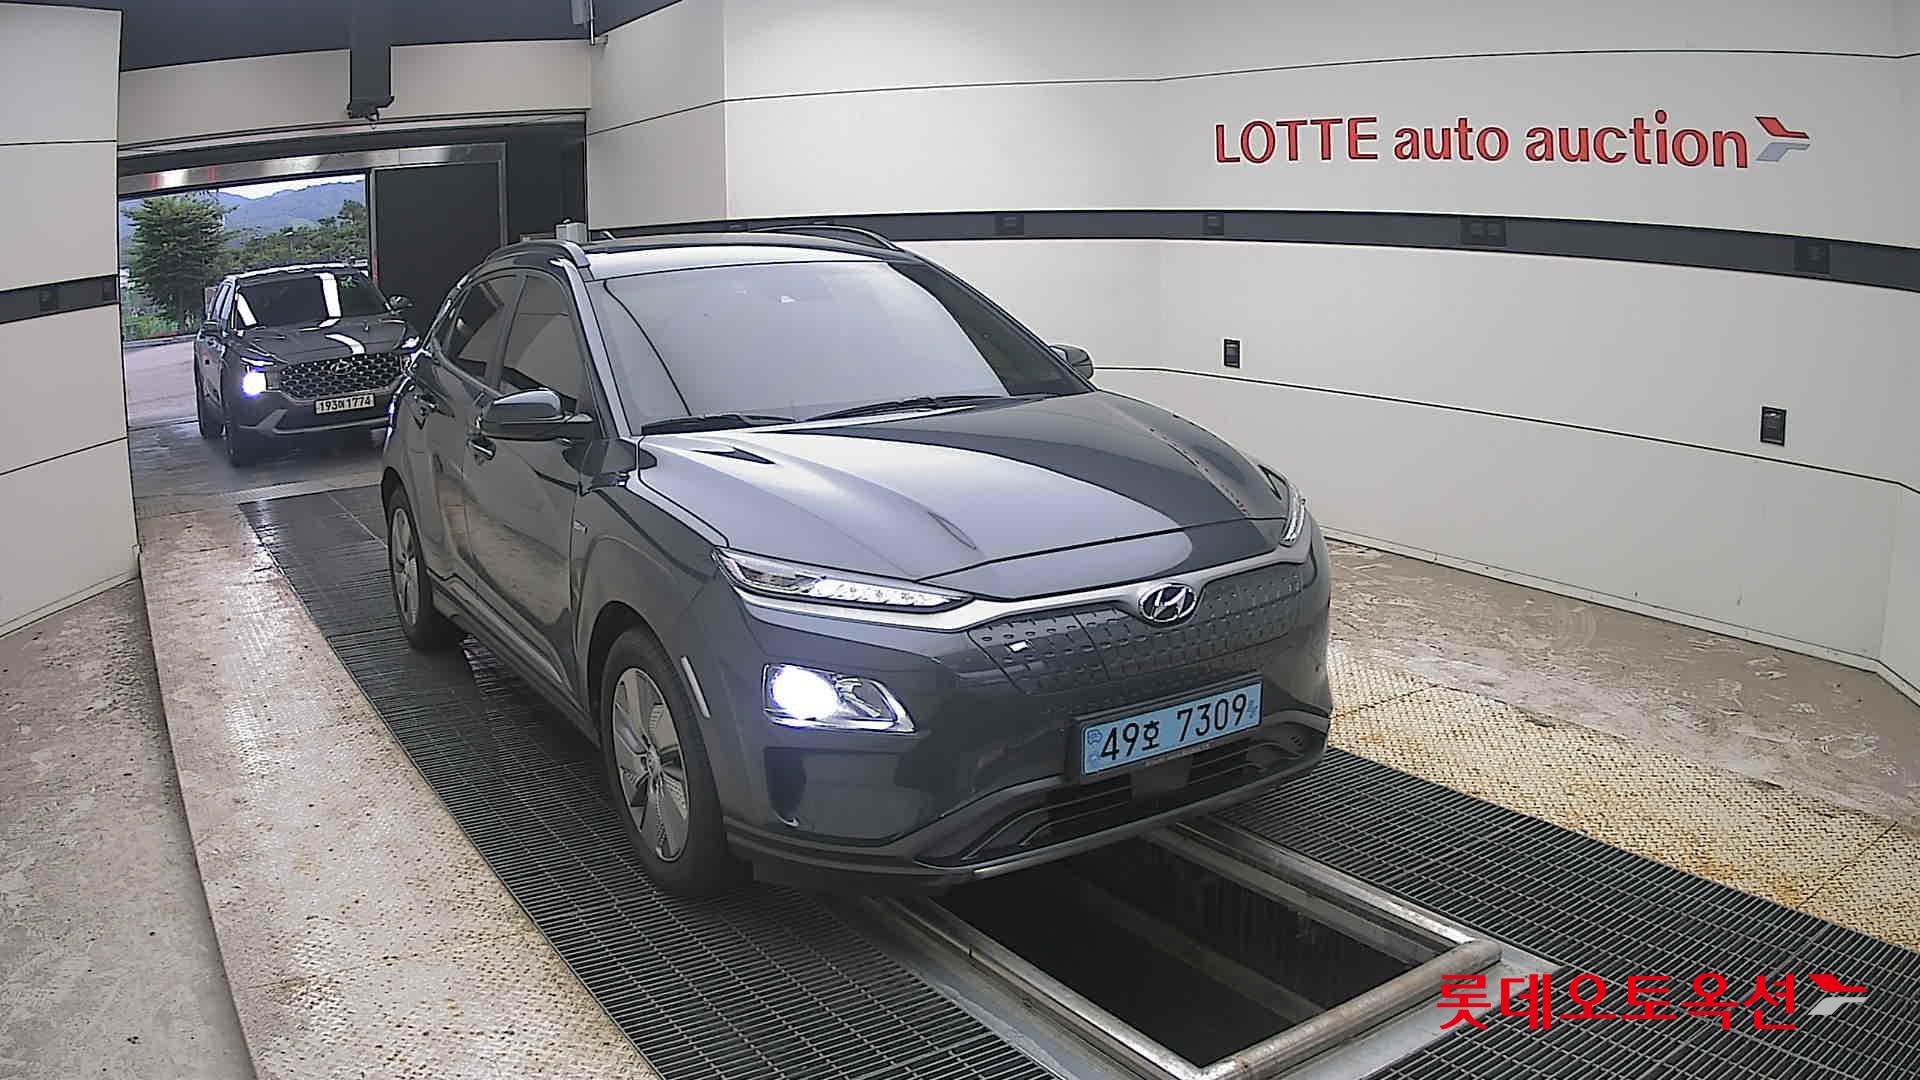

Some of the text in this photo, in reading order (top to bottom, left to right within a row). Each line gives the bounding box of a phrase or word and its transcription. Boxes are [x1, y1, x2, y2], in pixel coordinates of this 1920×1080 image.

[1215, 110, 1748, 168] LOTTE auto auction
[1100, 693, 1248, 761] 49호 7309
